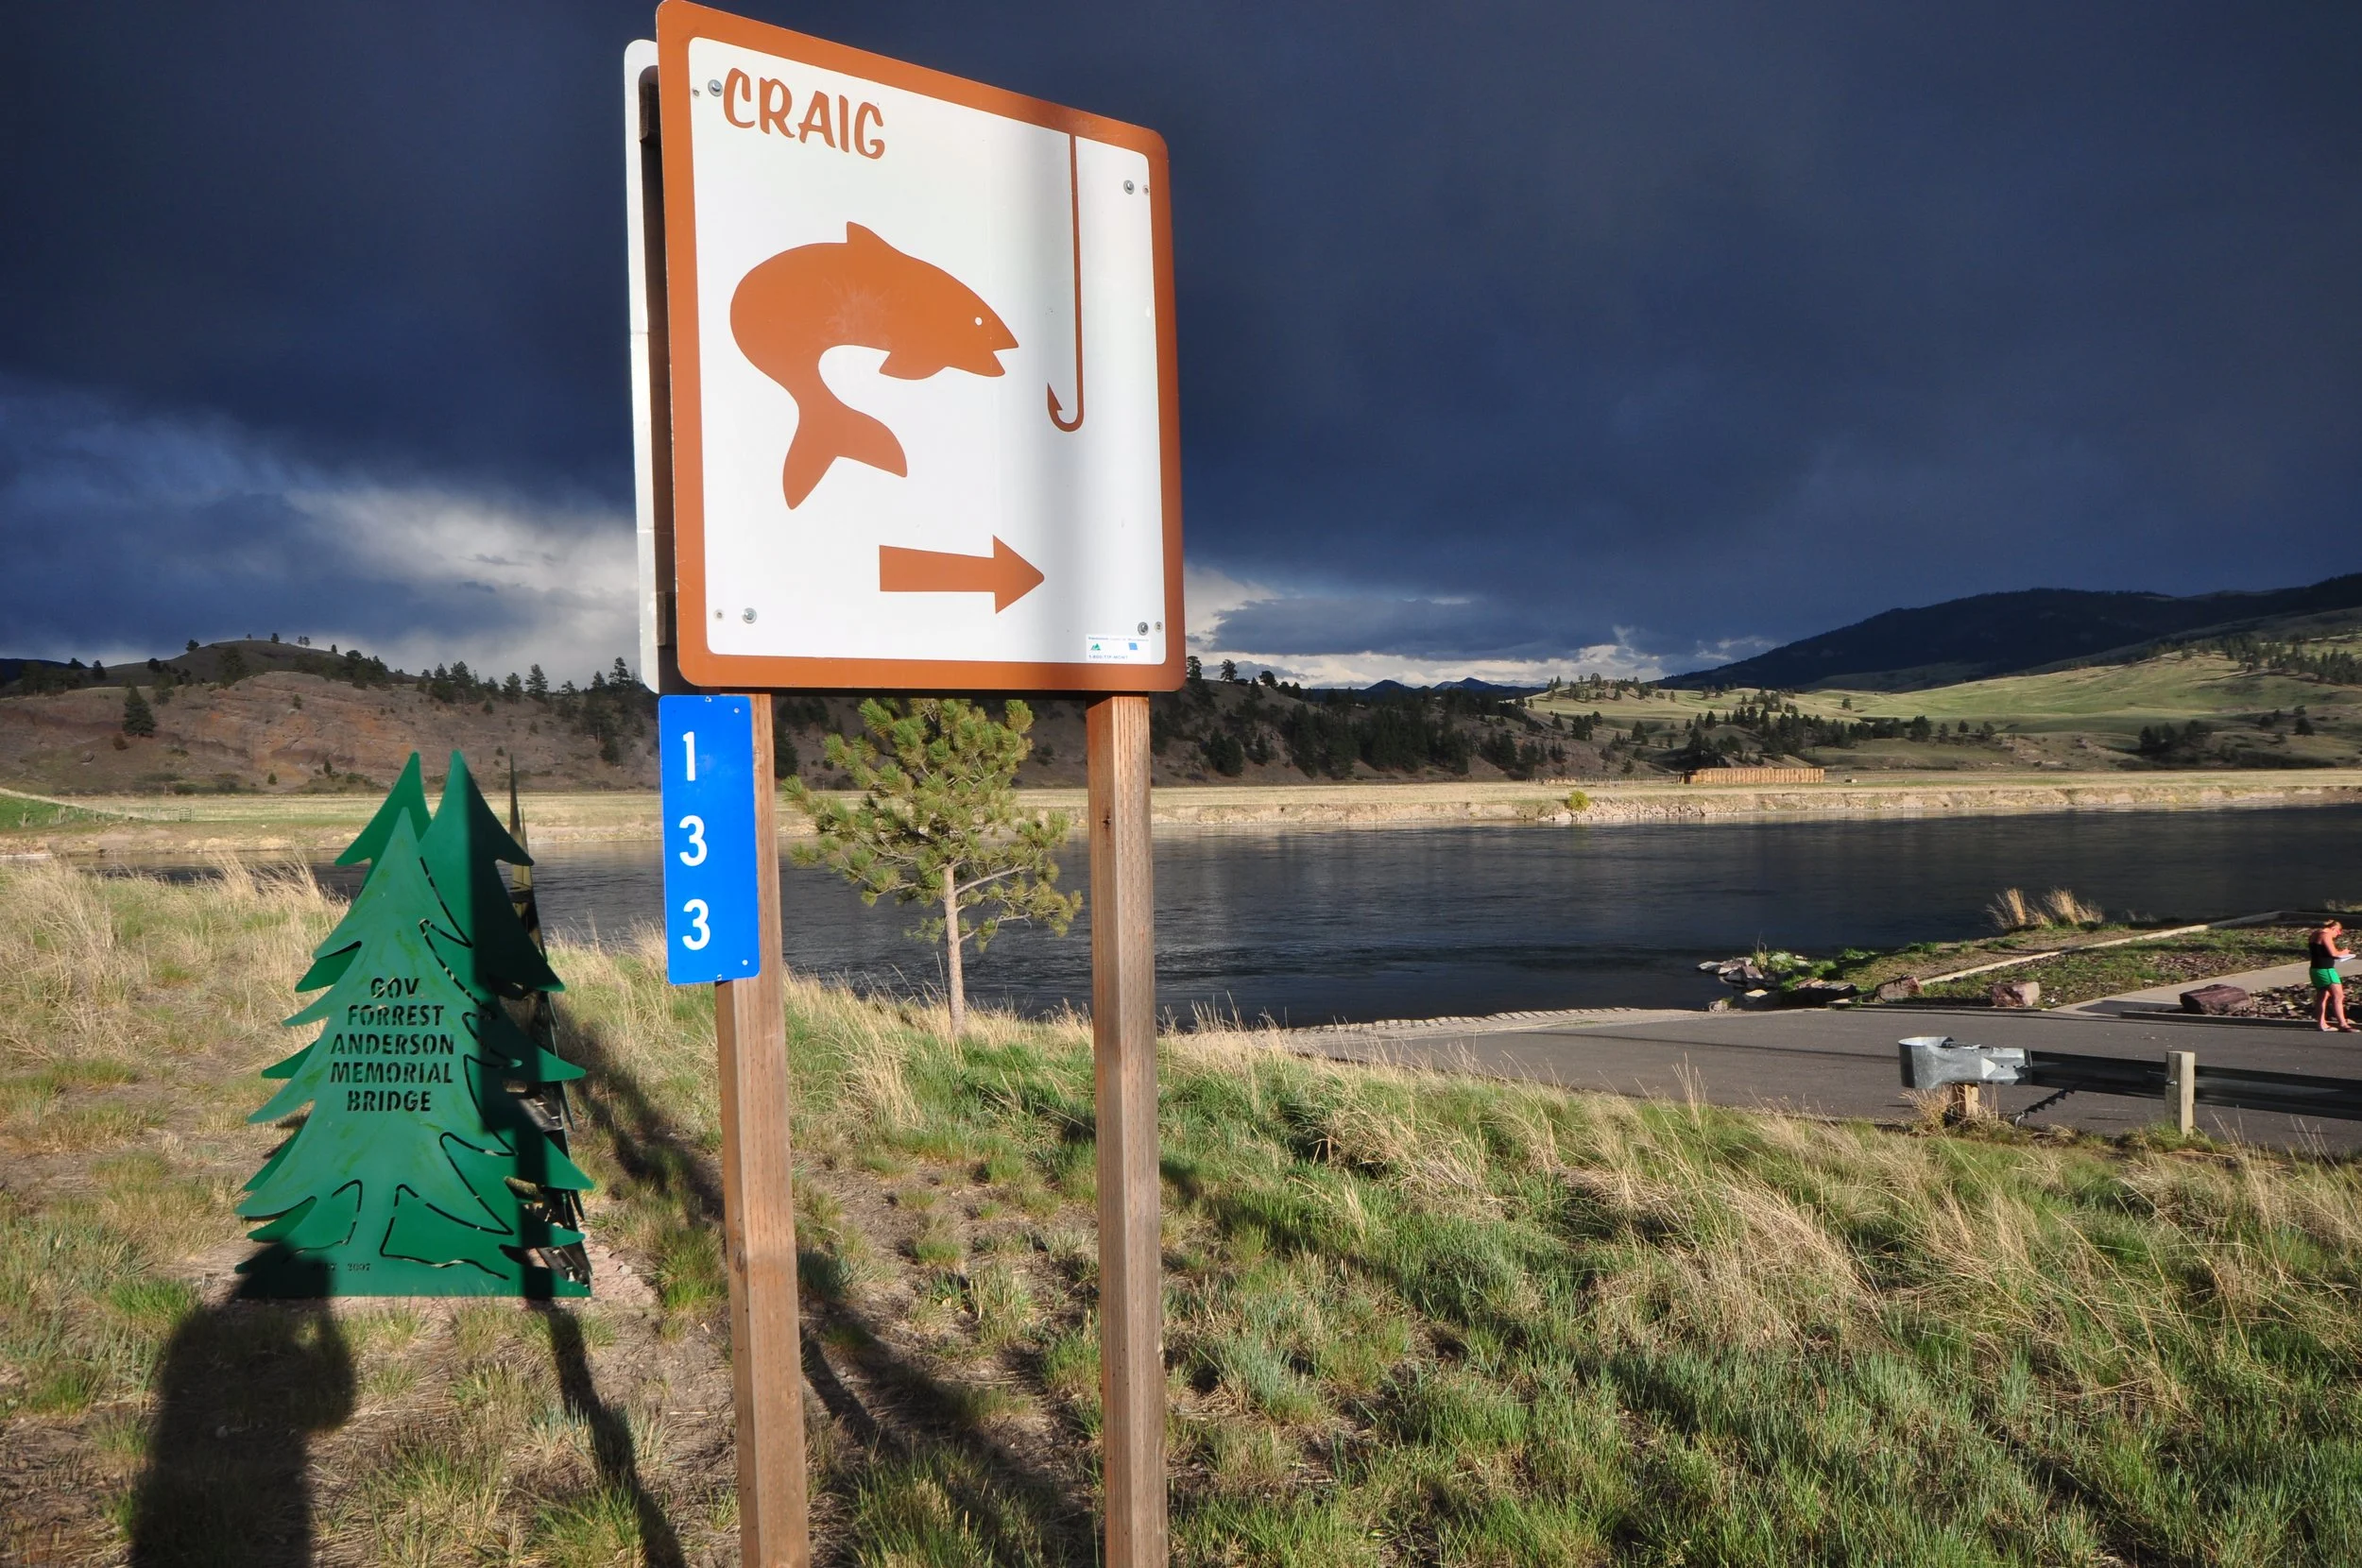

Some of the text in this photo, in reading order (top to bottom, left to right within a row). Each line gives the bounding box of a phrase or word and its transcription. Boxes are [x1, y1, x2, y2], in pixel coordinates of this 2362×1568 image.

[723, 67, 885, 160] CRAIG
[347, 1004, 445, 1026] FORREST
[330, 1033, 454, 1055] ANDERSON
[330, 1062, 454, 1083] MEMORIAL
[346, 1090, 432, 1112] BRIDGE
